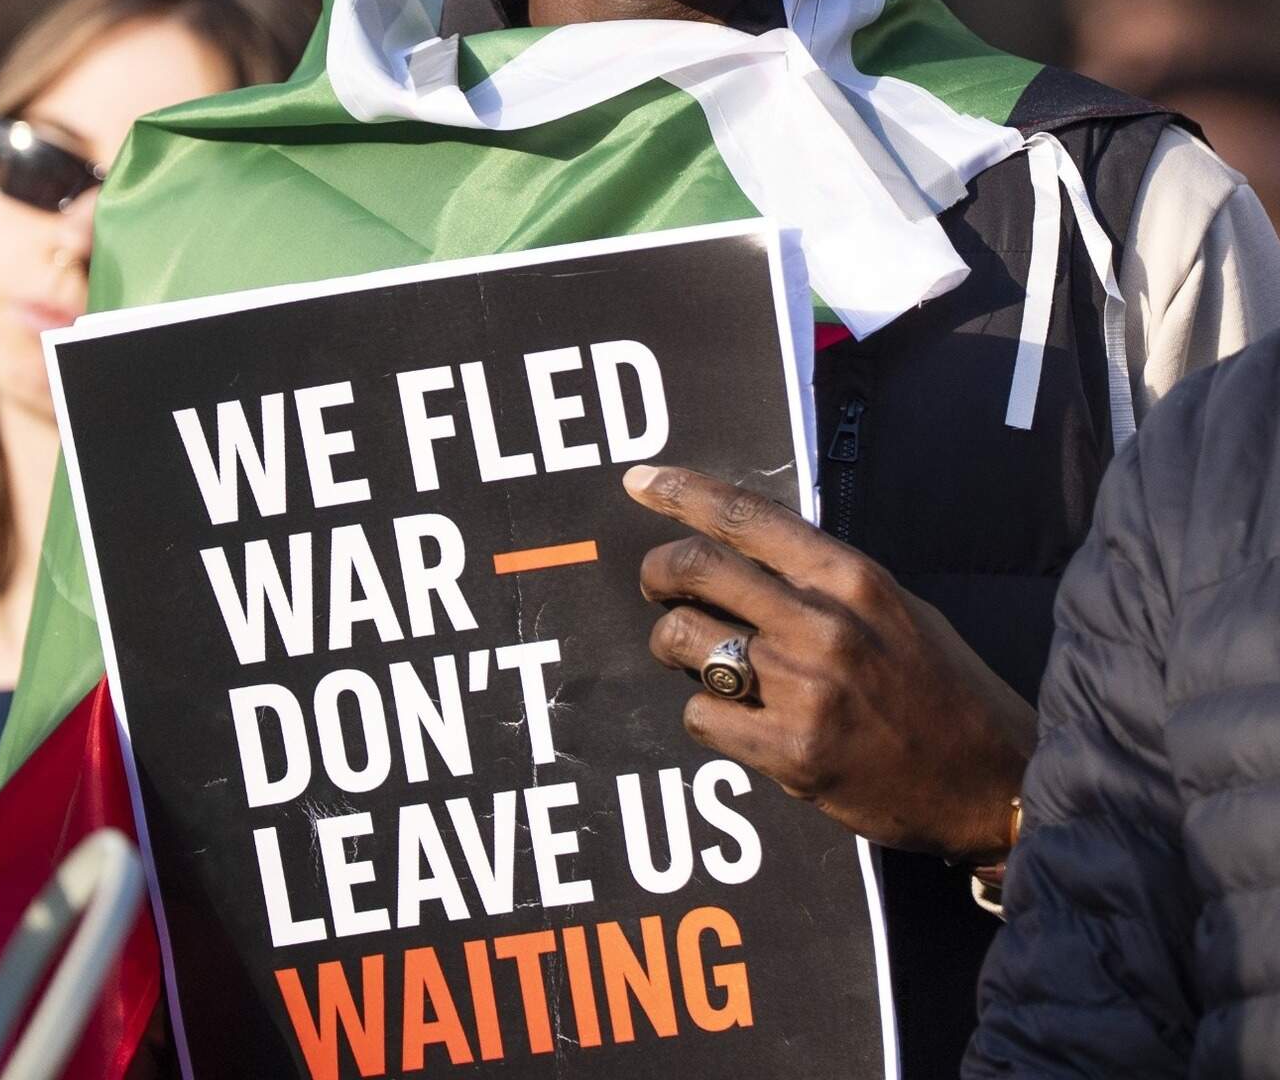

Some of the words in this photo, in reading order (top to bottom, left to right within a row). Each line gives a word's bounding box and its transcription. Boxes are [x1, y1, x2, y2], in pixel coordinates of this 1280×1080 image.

[172, 380, 371, 526] WE
[395, 339, 670, 493] FLED
[200, 513, 480, 665] WAR
[228, 638, 562, 809] DON’T
[252, 781, 595, 948] LEAVE
[616, 759, 763, 895] US
[273, 906, 754, 1080] WAITING
